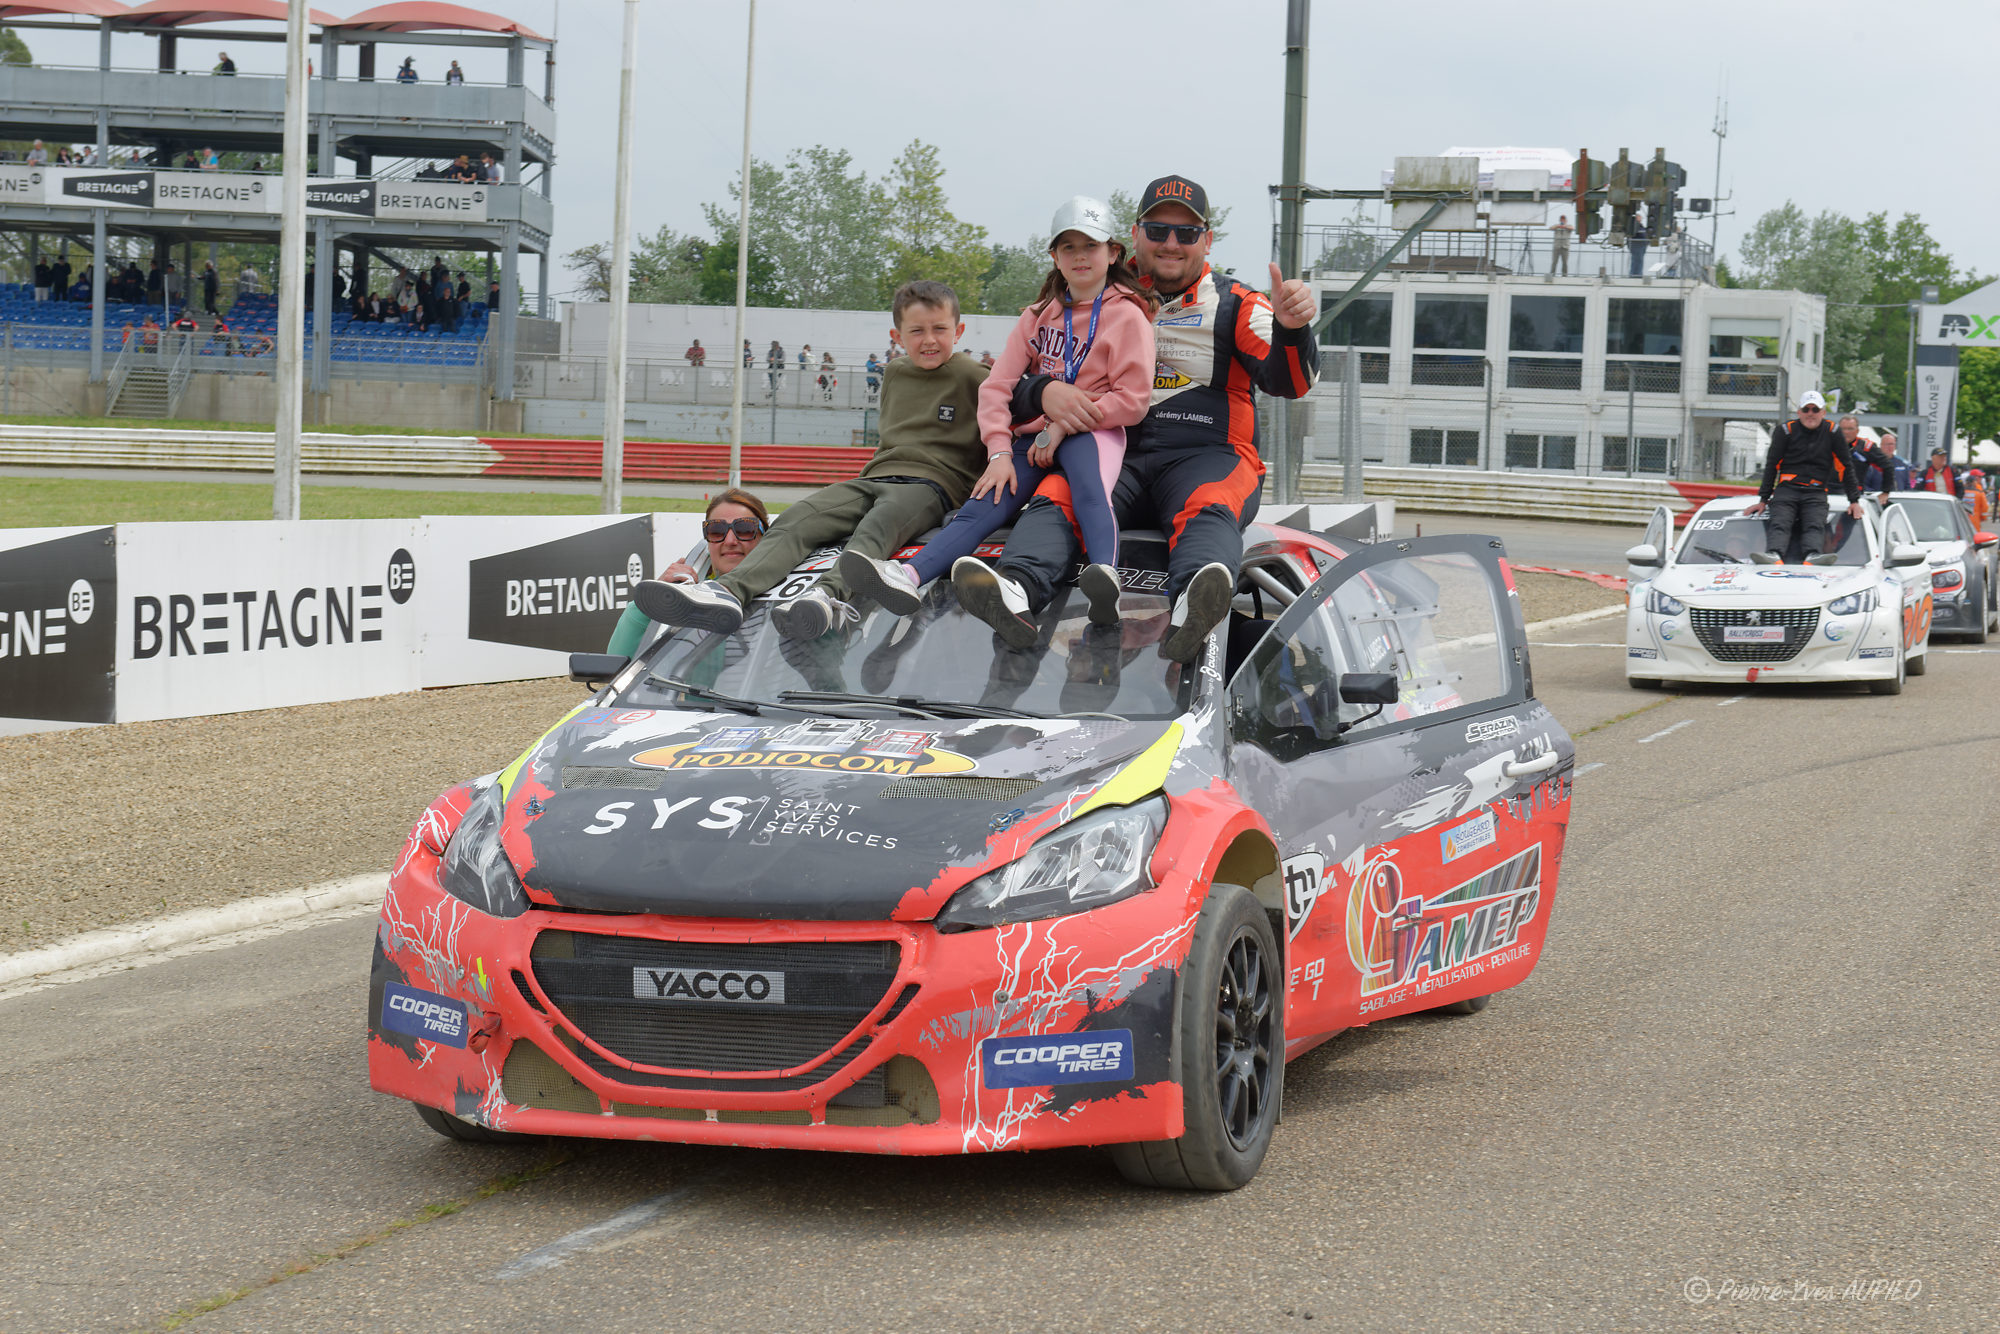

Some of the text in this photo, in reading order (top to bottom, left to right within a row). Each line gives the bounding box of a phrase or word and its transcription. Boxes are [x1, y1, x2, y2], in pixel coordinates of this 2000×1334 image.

[77, 182, 139, 194] BRETAGNE
[159, 185, 249, 200] BRETAGNE
[306, 191, 360, 203] RETAGNE
[1156, 181, 1193, 201] KULTE
[381, 194, 471, 210] BRETAGNE
[1183, 413, 1213, 424] LAMBEC
[1927, 384, 1939, 447] BRETAGNE
[1698, 520, 1723, 530] 129
[506, 575, 628, 616] BRETAGNE
[134, 585, 382, 659] BRETAGNE
[675, 751, 916, 775] PODIOCOM
[582, 796, 759, 834] SYS
[778, 798, 861, 815] SAINT
[772, 809, 840, 827] YVES
[763, 820, 899, 850] SERVICES
[648, 971, 770, 1000] YACCO
[1358, 989, 1407, 1015] SABLAGE
[1491, 943, 1531, 968] PEINTURE
[389, 994, 463, 1025] COOPER
[424, 1018, 460, 1036] TIRES
[994, 1041, 1123, 1065] COOPER
[1057, 1057, 1121, 1073] TIRES
